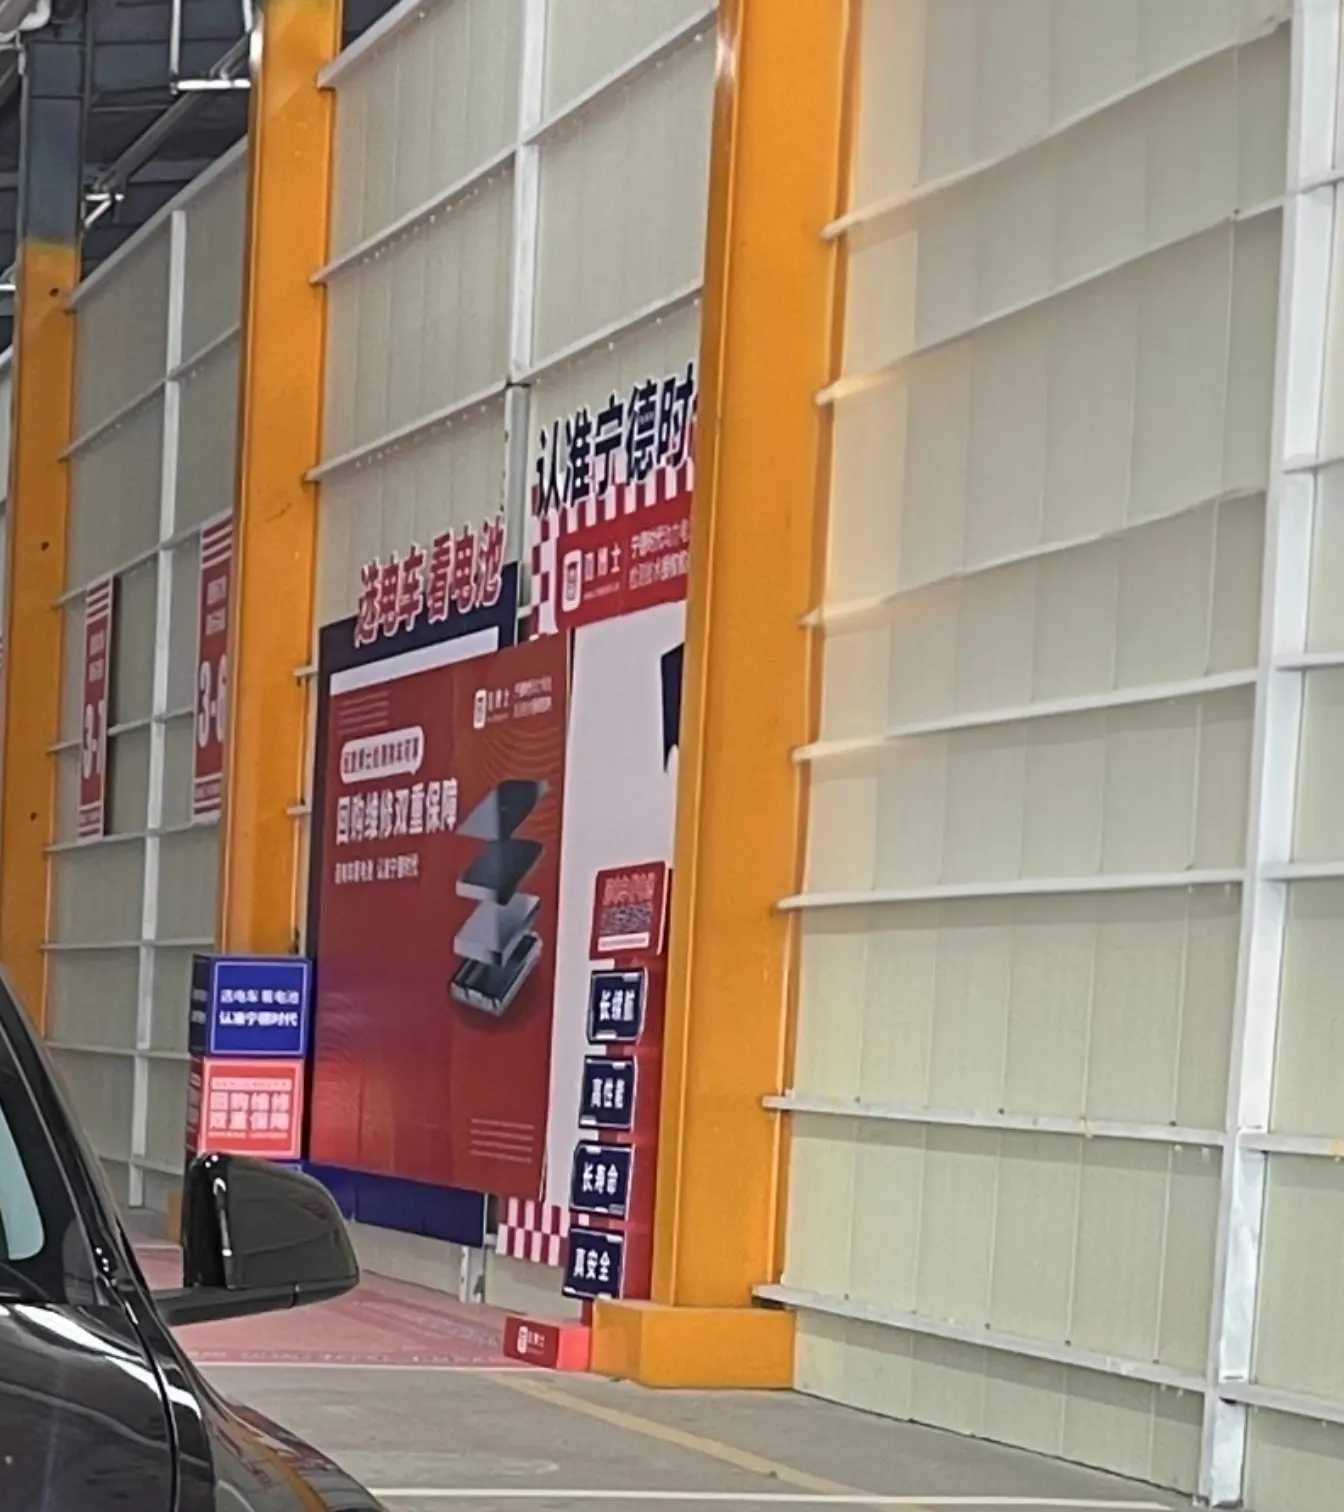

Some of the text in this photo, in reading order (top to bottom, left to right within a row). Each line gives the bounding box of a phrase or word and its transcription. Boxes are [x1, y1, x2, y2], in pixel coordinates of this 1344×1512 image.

[536, 362, 698, 517] 认准宁德时
[355, 508, 507, 647] 选电车 看电池
[336, 777, 458, 845] 回购维修双重保障
